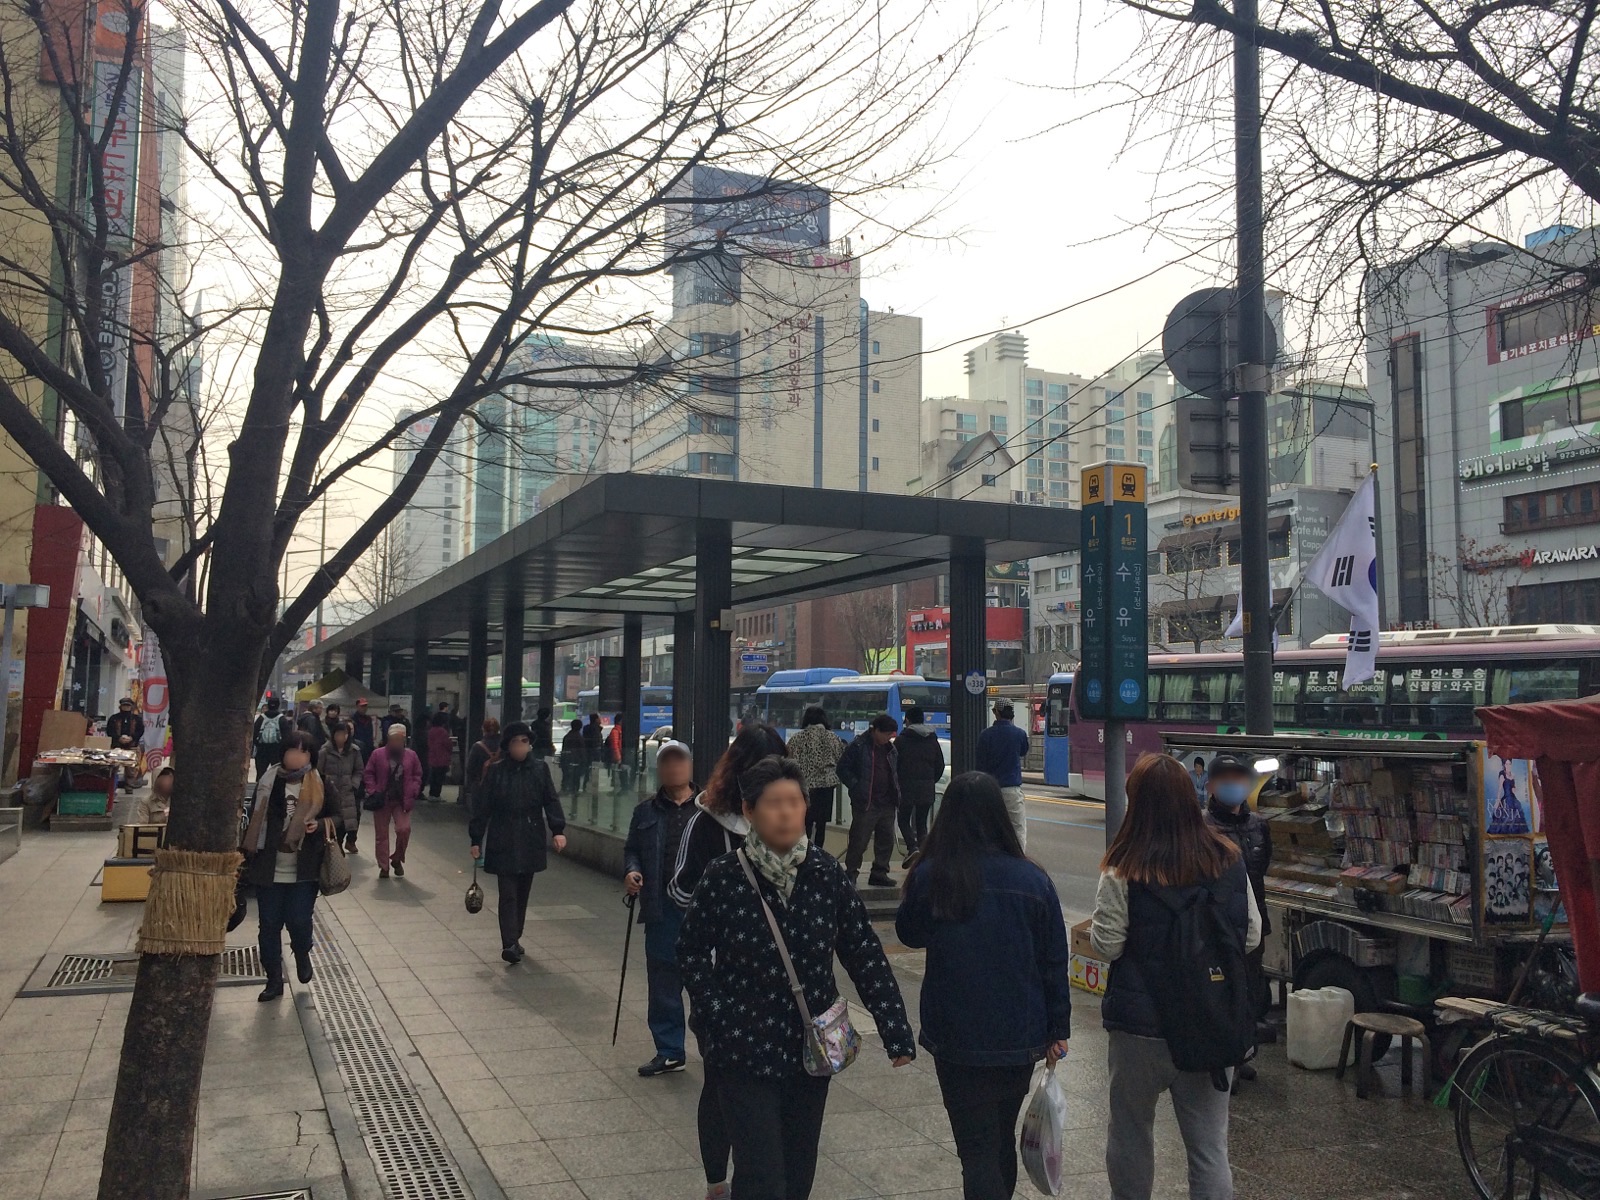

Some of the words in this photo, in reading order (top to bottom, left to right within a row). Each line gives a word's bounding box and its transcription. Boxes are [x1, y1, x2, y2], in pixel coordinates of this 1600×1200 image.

[1090, 515, 1097, 537] 1
[1124, 513, 1132, 535] 1
[971, 680, 984, 688] 338
